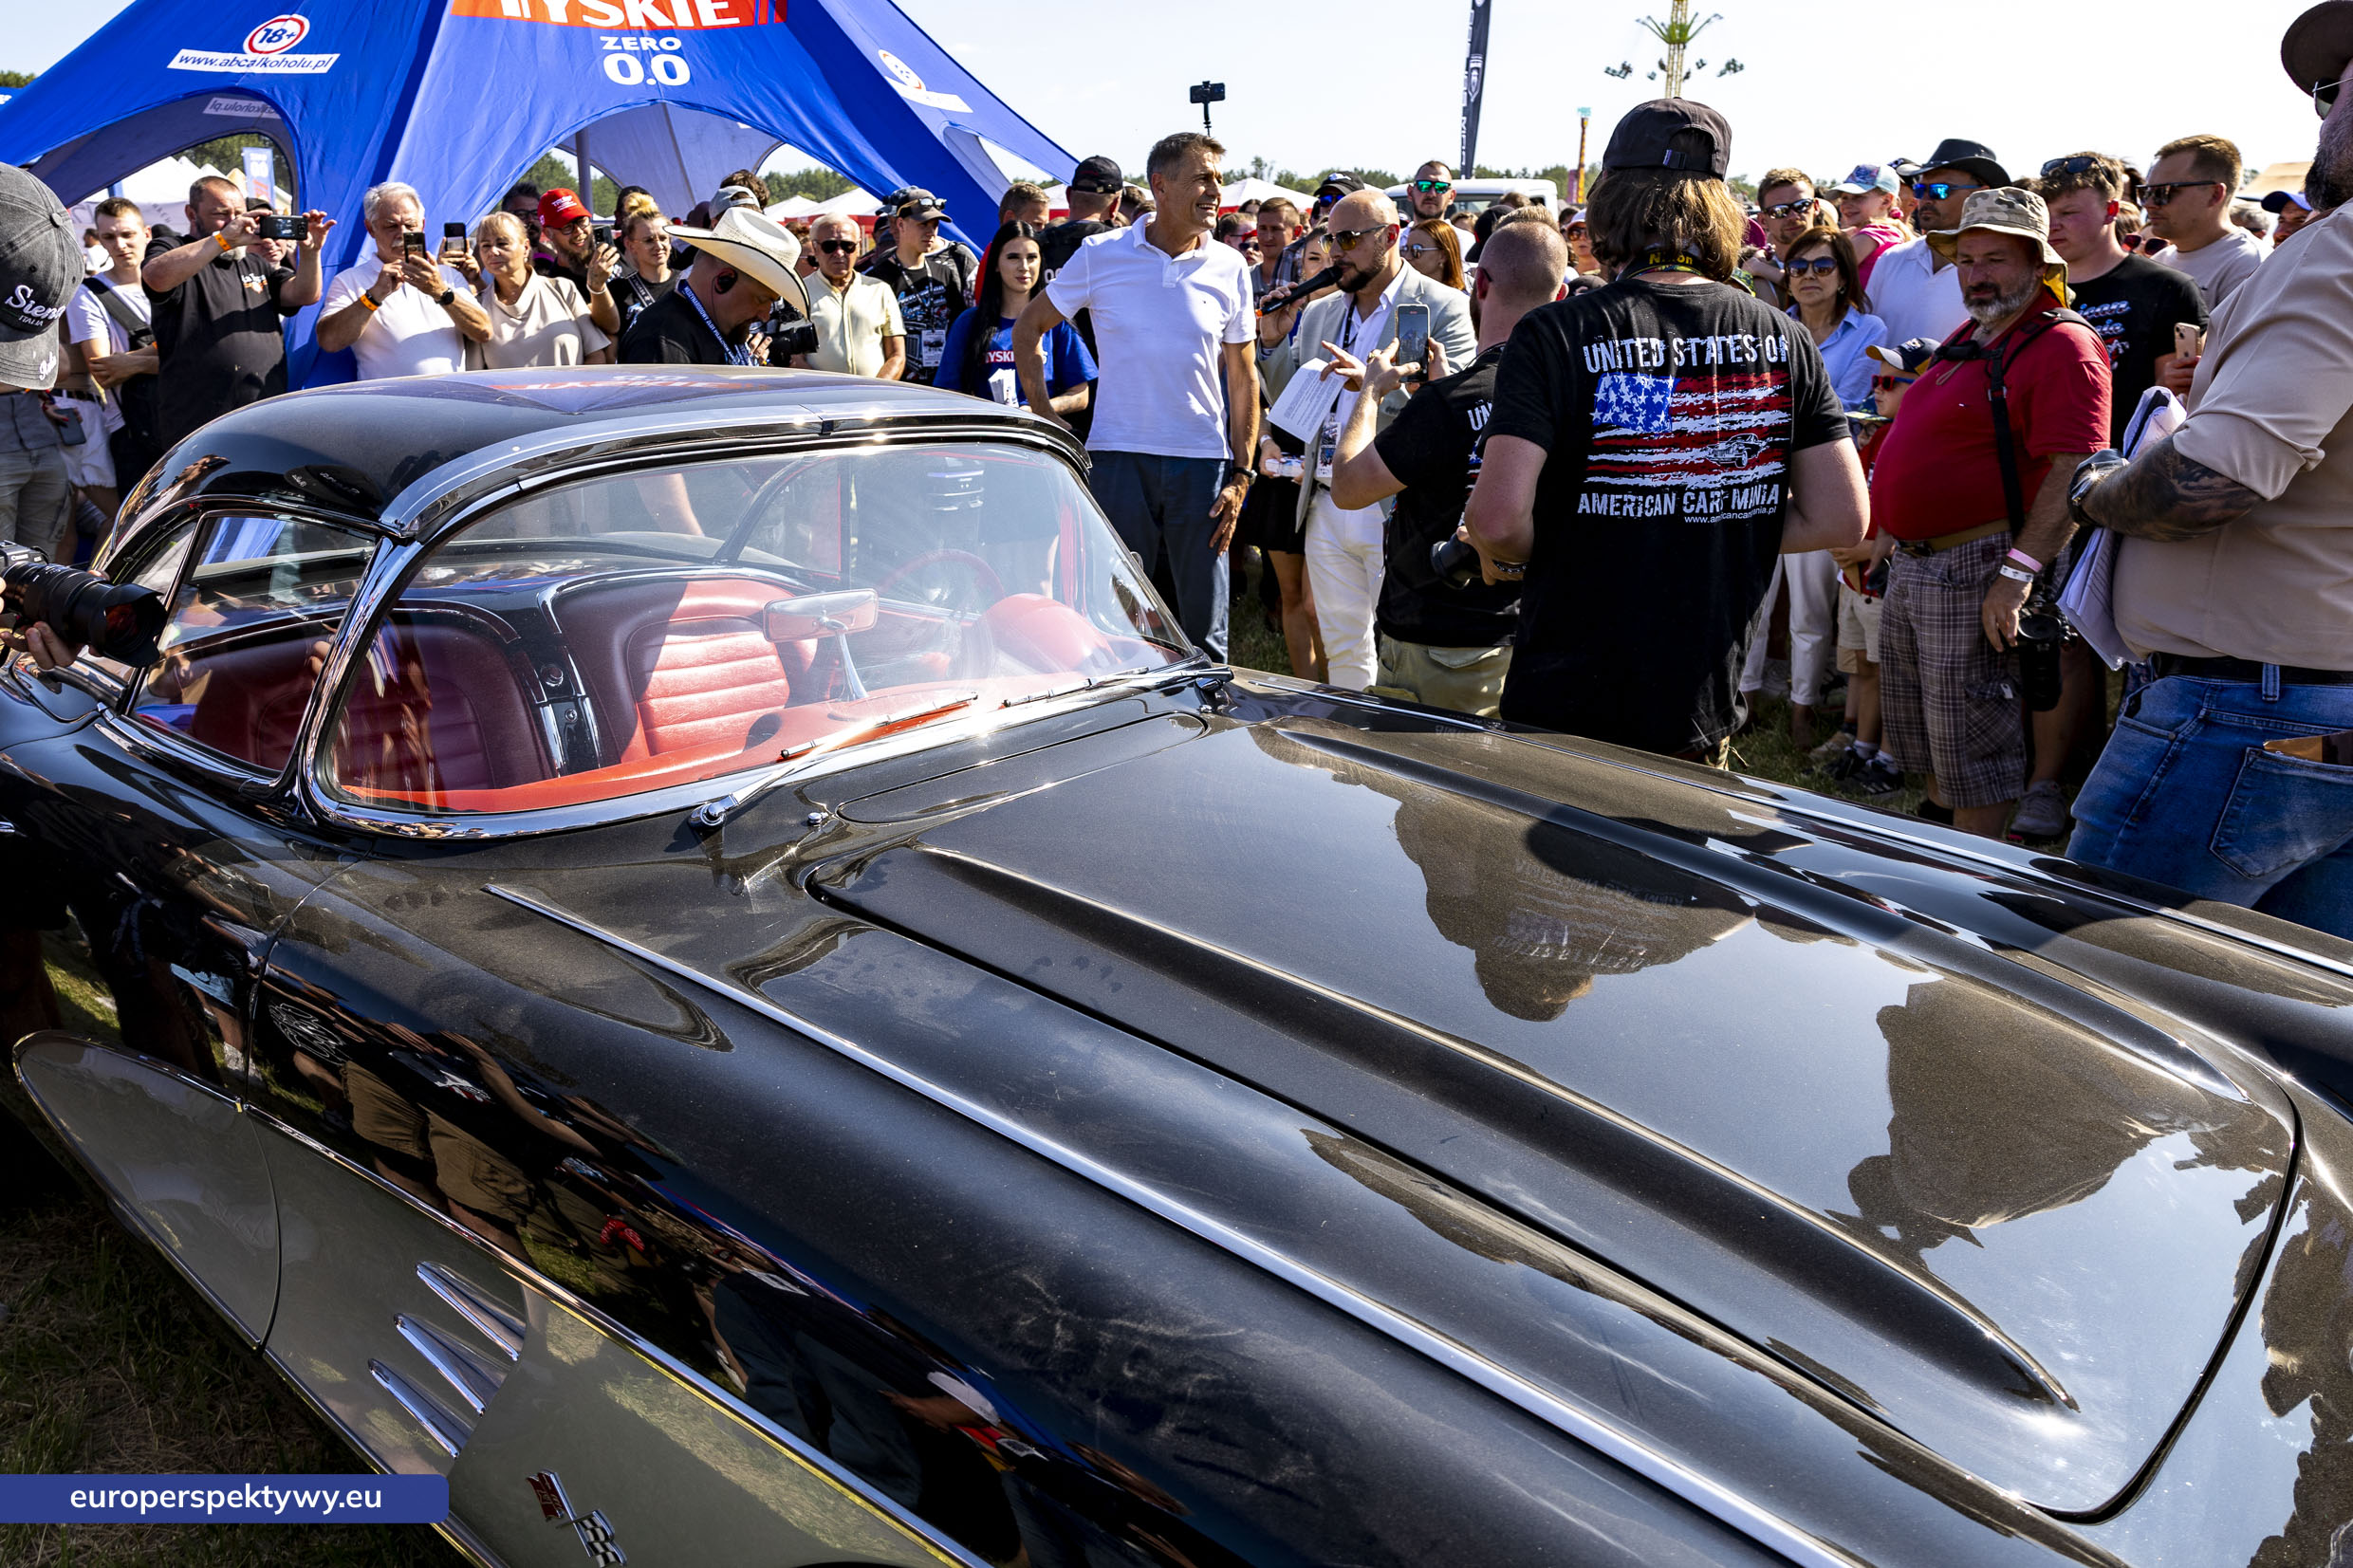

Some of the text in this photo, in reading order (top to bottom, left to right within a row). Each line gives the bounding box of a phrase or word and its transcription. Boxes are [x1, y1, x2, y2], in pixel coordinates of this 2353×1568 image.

[258, 28, 297, 44] 18+
[600, 36, 681, 51] ZERO
[178, 55, 333, 70] www.abcalkoholu.pl
[602, 53, 691, 86] 0.0
[1649, 251, 1693, 265] Non
[19, 315, 44, 326] ITALIA
[986, 351, 1015, 363] YSKI
[1583, 337, 1667, 373] UNITED
[1672, 334, 1758, 366] STATES
[1577, 492, 1677, 517] AMERICAN
